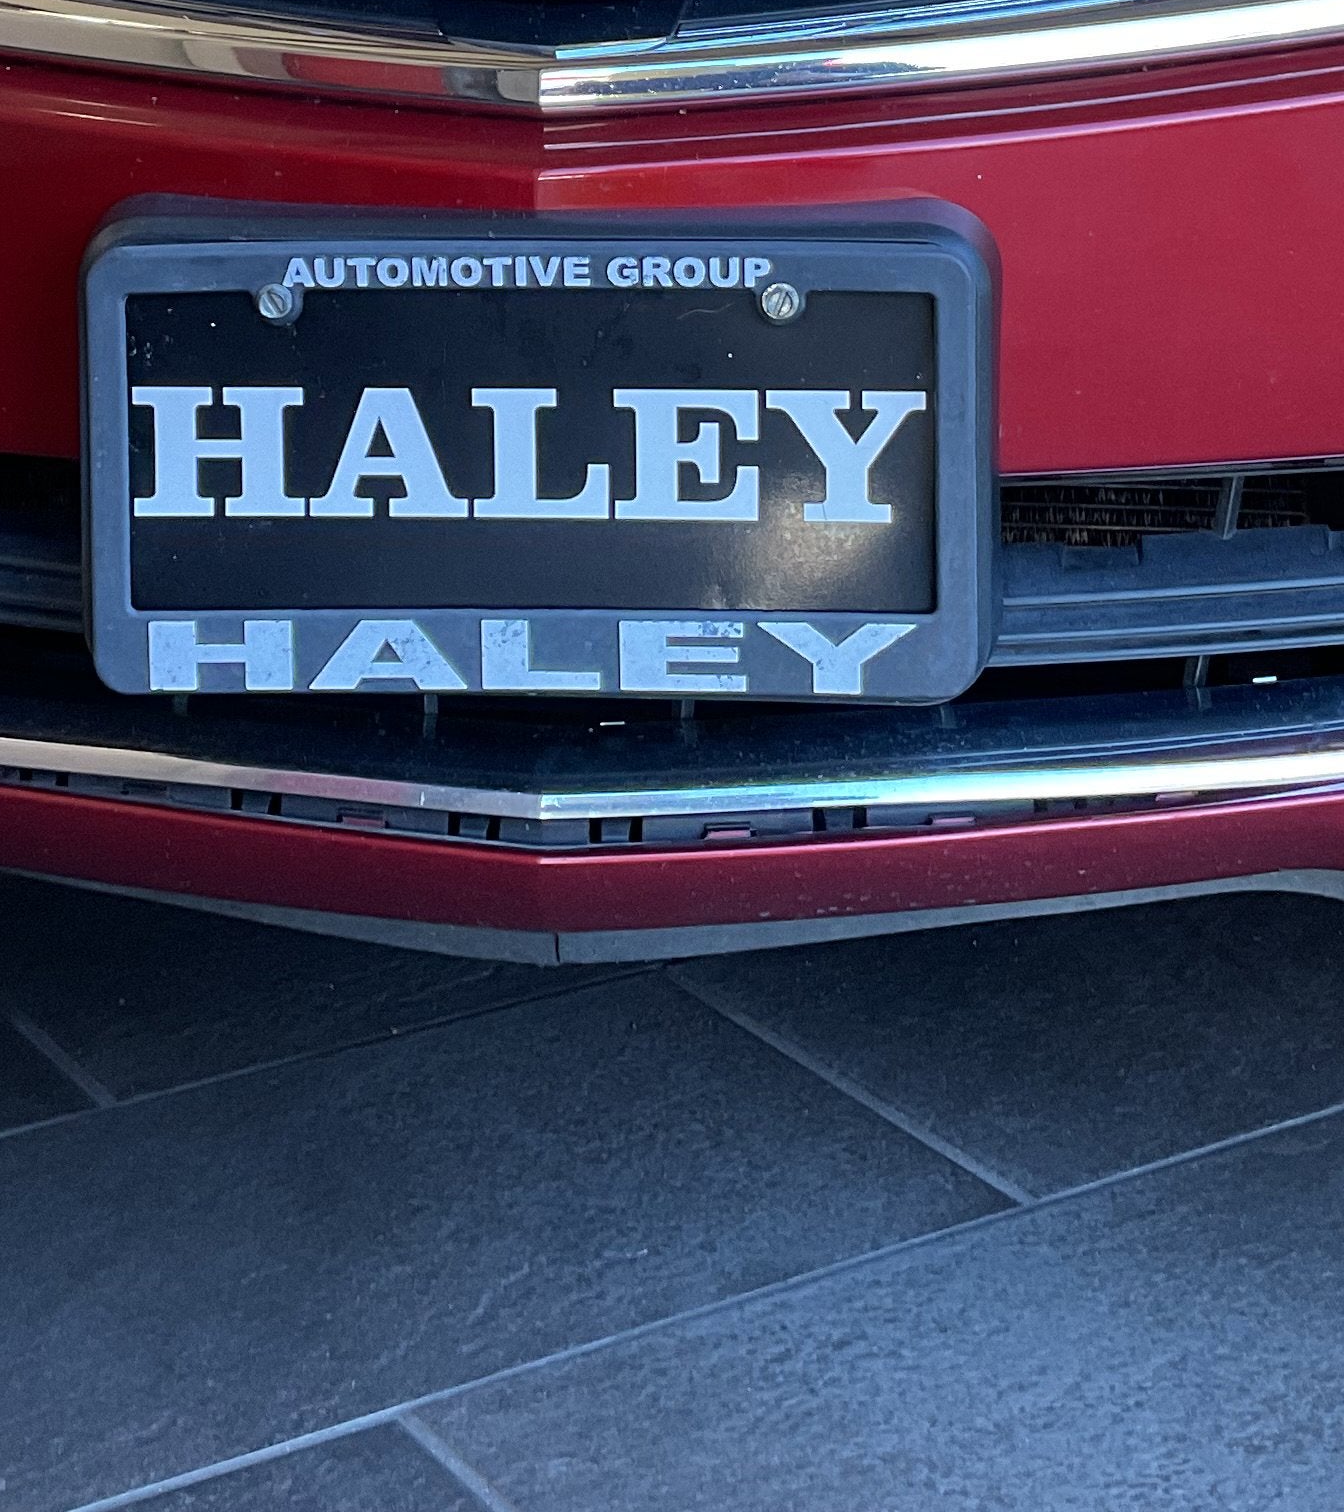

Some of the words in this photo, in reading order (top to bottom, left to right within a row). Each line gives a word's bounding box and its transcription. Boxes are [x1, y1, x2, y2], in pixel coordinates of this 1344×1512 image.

[282, 255, 592, 289] AUTOMOTIVE
[606, 255, 773, 289] GROUP
[131, 386, 927, 524] HALEY
[146, 618, 918, 696] HALEY
